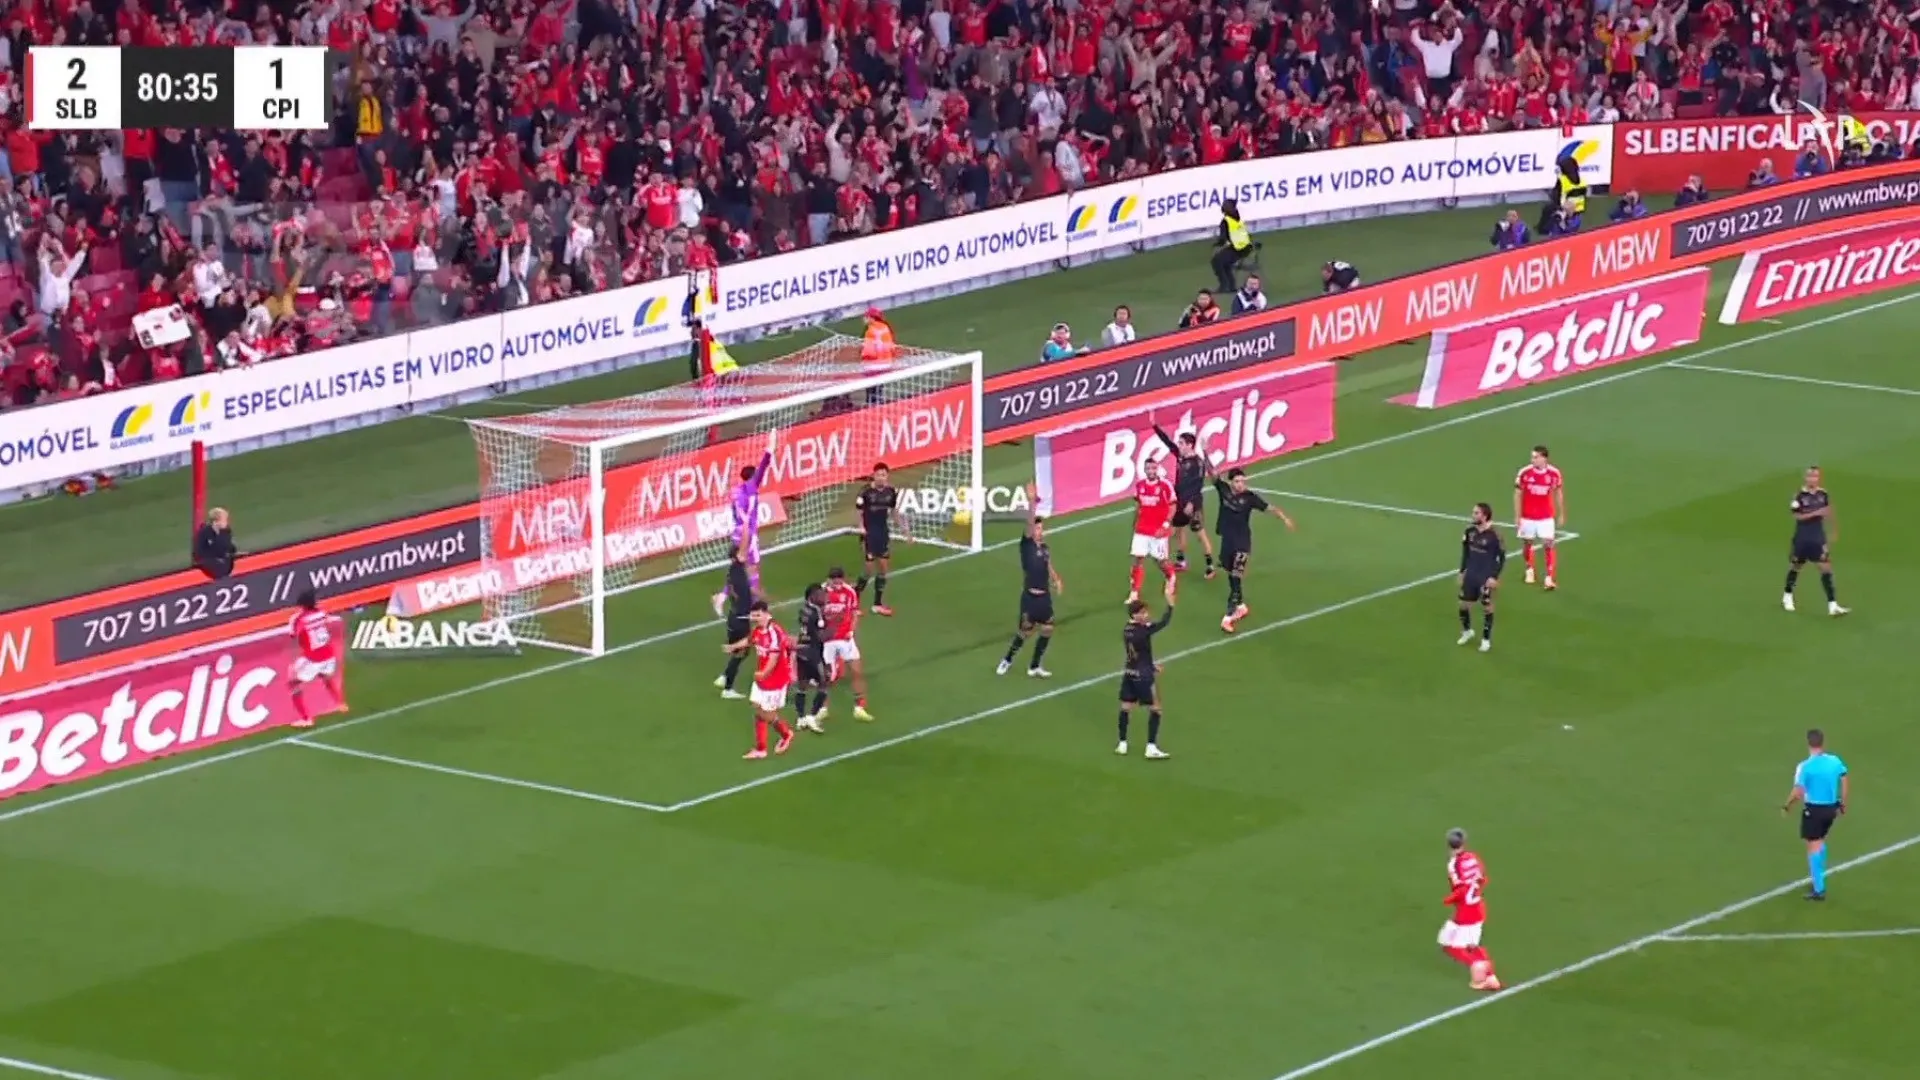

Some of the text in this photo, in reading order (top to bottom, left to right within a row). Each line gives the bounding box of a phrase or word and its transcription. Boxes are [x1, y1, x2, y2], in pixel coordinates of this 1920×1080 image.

[1147, 152, 1544, 218] ESPECIALISTAS EM VIDRO AUTOMÓVEL
[1687, 221, 1717, 248] 707
[1719, 217, 1737, 238] 91
[1740, 211, 1759, 233] 22
[1764, 205, 1783, 227] 22
[1818, 180, 1920, 213] www.mbw.p
[726, 220, 1058, 312] ESPECIALISTAS EM VIDRO AUTOMÓVEL
[1307, 228, 1660, 351] MBW MBW MBW MBW
[224, 315, 625, 420] ESPECIALISTAS EM VIDRO AUTOMÓVEL
[1000, 391, 1034, 419] 707
[1039, 385, 1059, 410] 91
[1065, 377, 1090, 403] 22
[1095, 371, 1119, 398] 22
[1162, 331, 1276, 377] www.mbw.pt
[1477, 292, 1664, 391] Betclic
[637, 458, 732, 519] MBW
[760, 428, 851, 487] MBW
[879, 400, 964, 456] MBW
[84, 611, 132, 648] 707
[139, 603, 167, 633] 91
[174, 594, 209, 626] 22
[216, 584, 249, 615] 22
[310, 530, 465, 589] www.mbw.pt
[417, 570, 502, 610] Betano
[513, 547, 593, 585] Betano
[606, 523, 685, 558] Betano
[0, 654, 277, 792] Betclic
